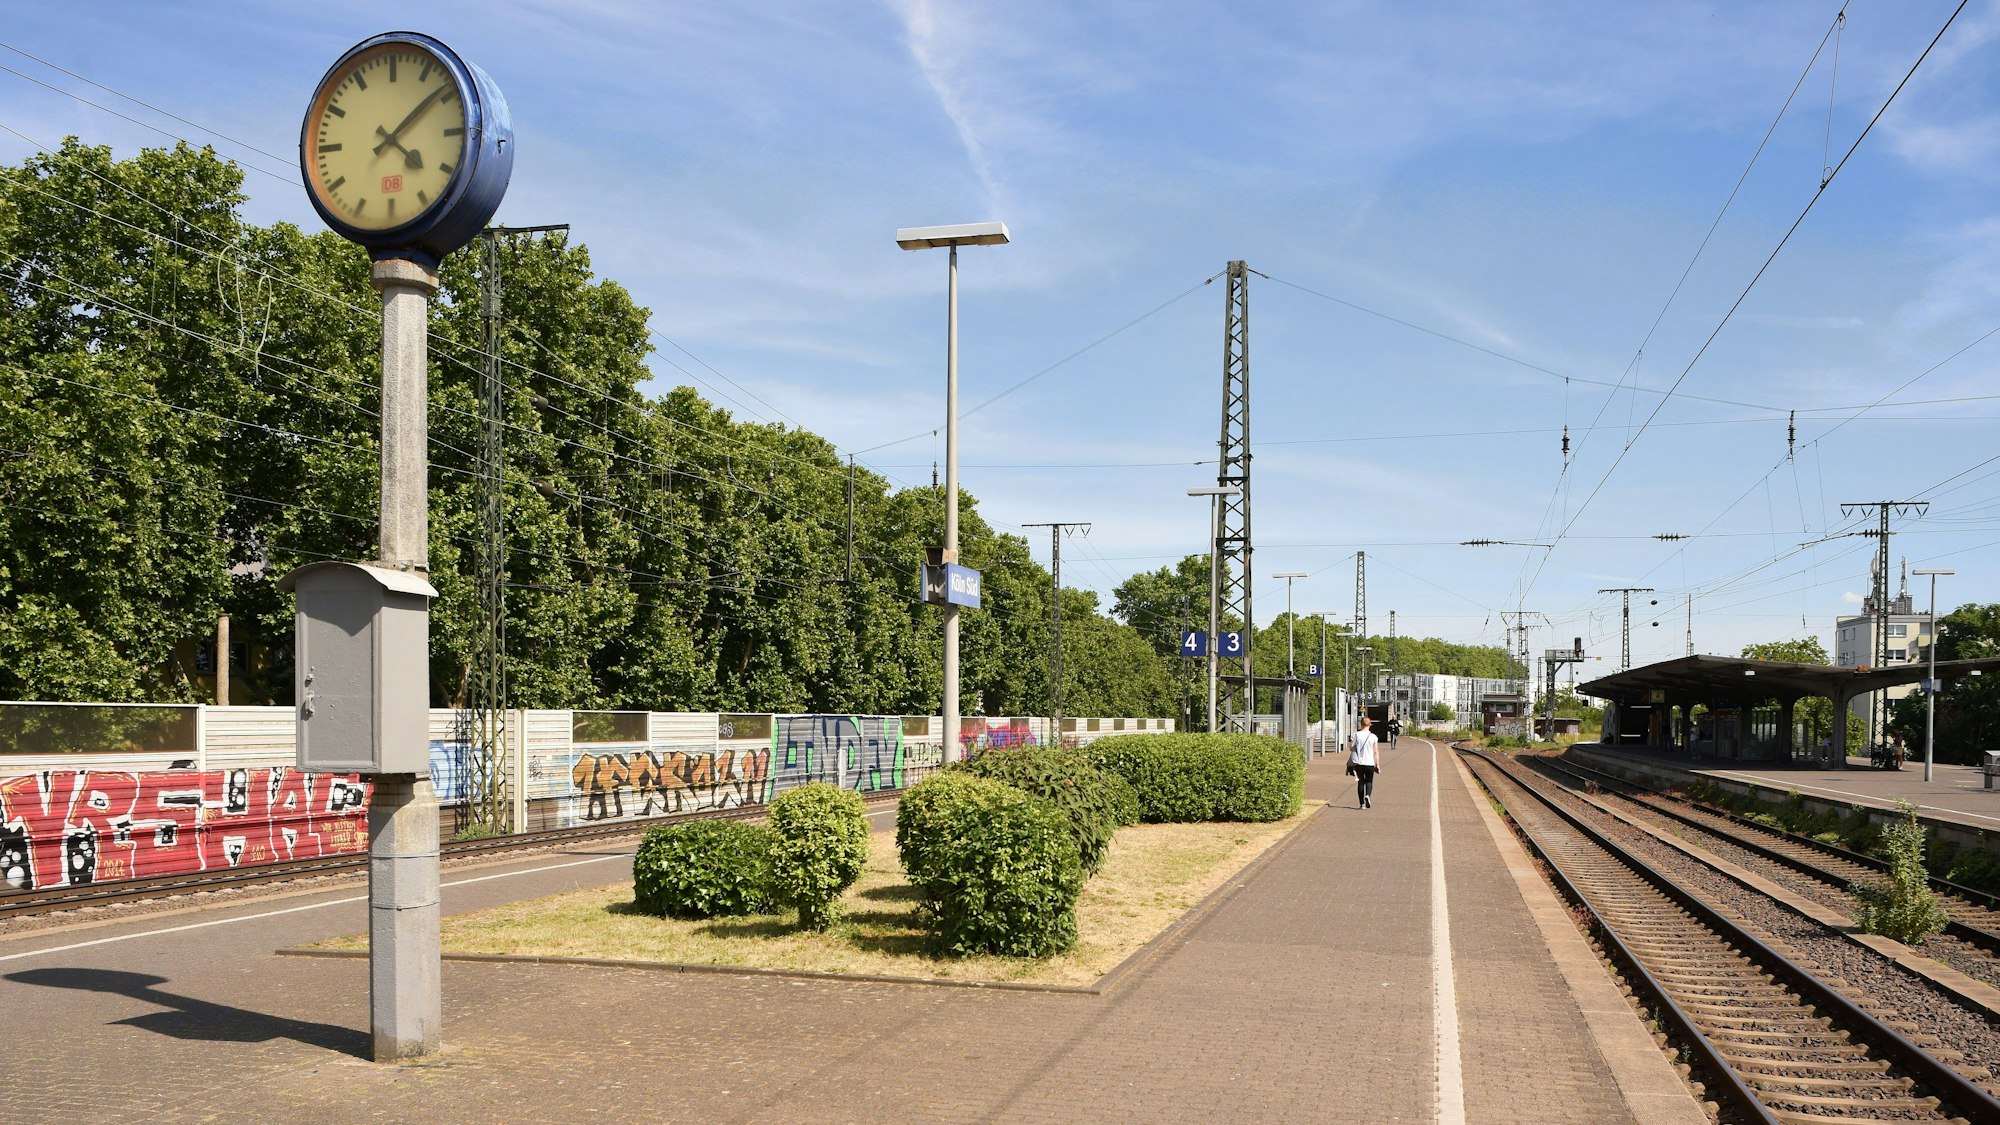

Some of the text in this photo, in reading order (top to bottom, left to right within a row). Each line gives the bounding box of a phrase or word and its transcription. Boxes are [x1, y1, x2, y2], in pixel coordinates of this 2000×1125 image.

[383, 176, 401, 191] DB
[951, 572, 979, 597] Köln Süd
[1185, 632, 1197, 651] 4
[1227, 632, 1240, 651] 3
[1309, 664, 1318, 675] B
